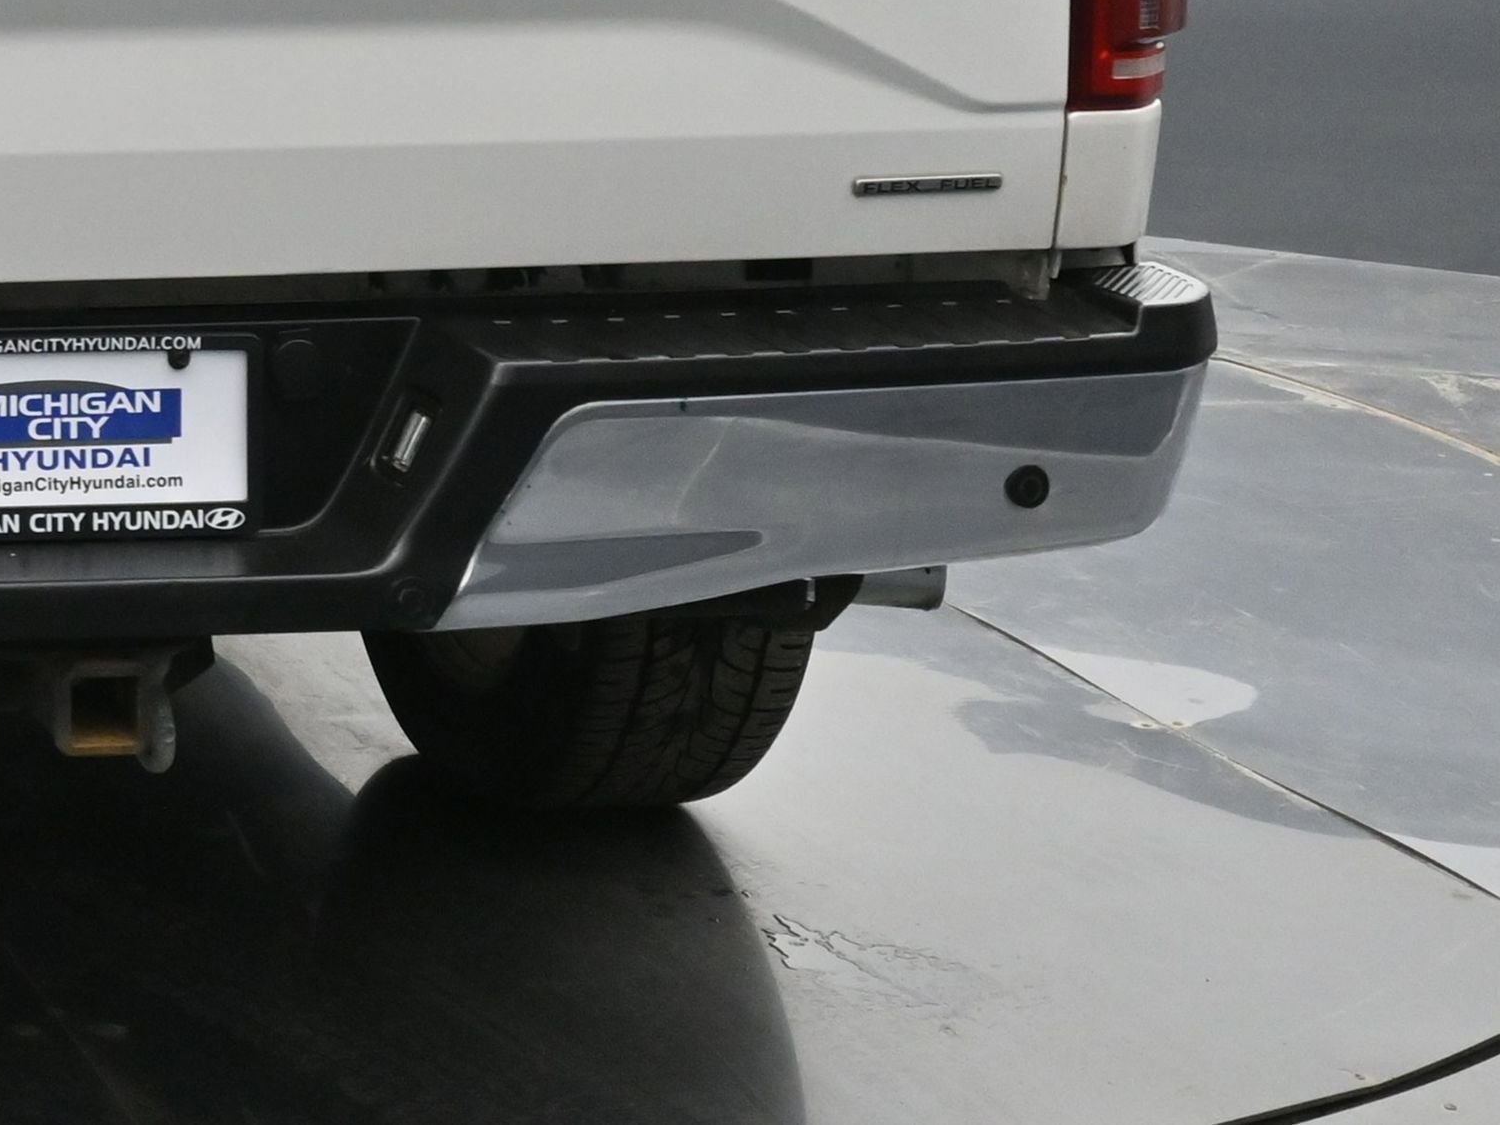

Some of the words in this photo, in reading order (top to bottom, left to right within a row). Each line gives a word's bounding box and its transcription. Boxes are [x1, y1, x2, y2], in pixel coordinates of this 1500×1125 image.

[862, 180, 921, 194] FLEX
[939, 177, 999, 190] FUEL
[27, 416, 110, 440] CITY
[29, 512, 85, 532] CITY
[92, 509, 204, 531] HYUNDAI
